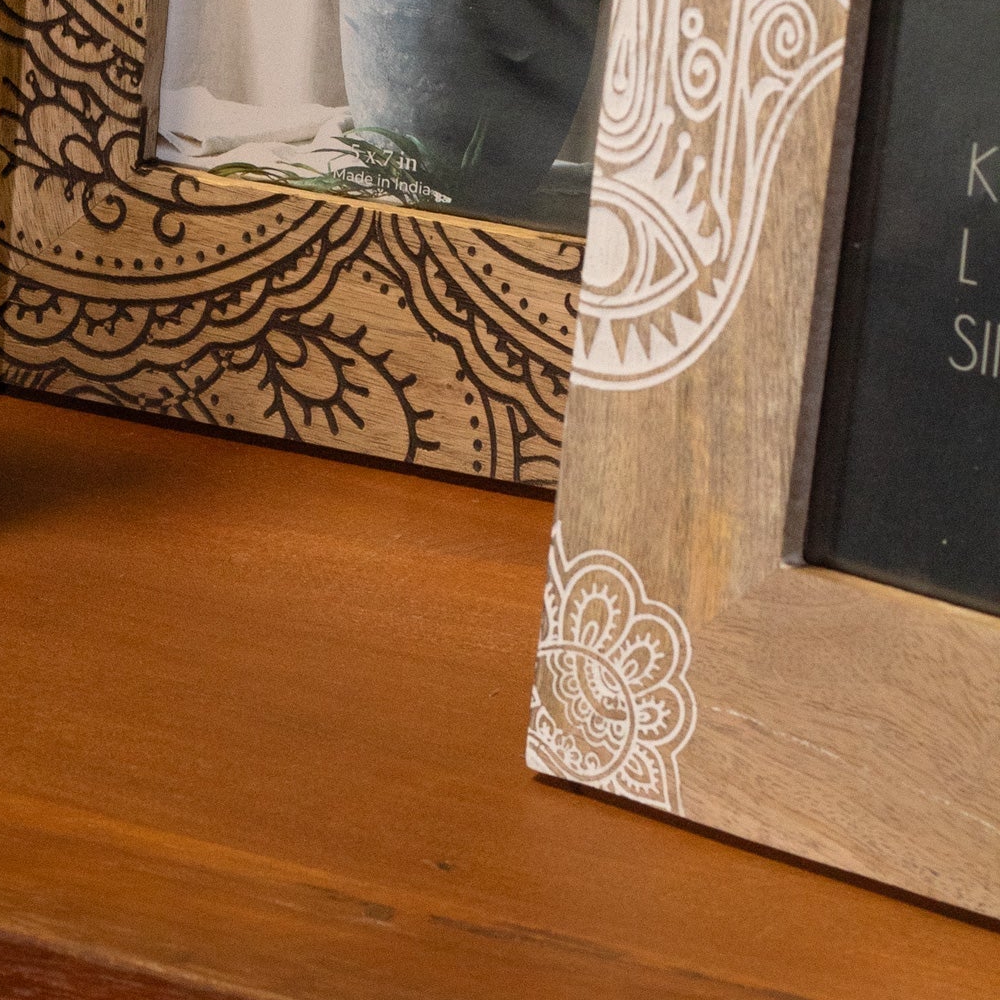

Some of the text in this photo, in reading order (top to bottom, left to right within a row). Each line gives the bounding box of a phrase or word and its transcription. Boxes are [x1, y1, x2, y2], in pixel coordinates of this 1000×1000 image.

[351, 143, 417, 172] 5 x 7 in
[332, 168, 431, 196] Made in India
[958, 227, 978, 286] L
